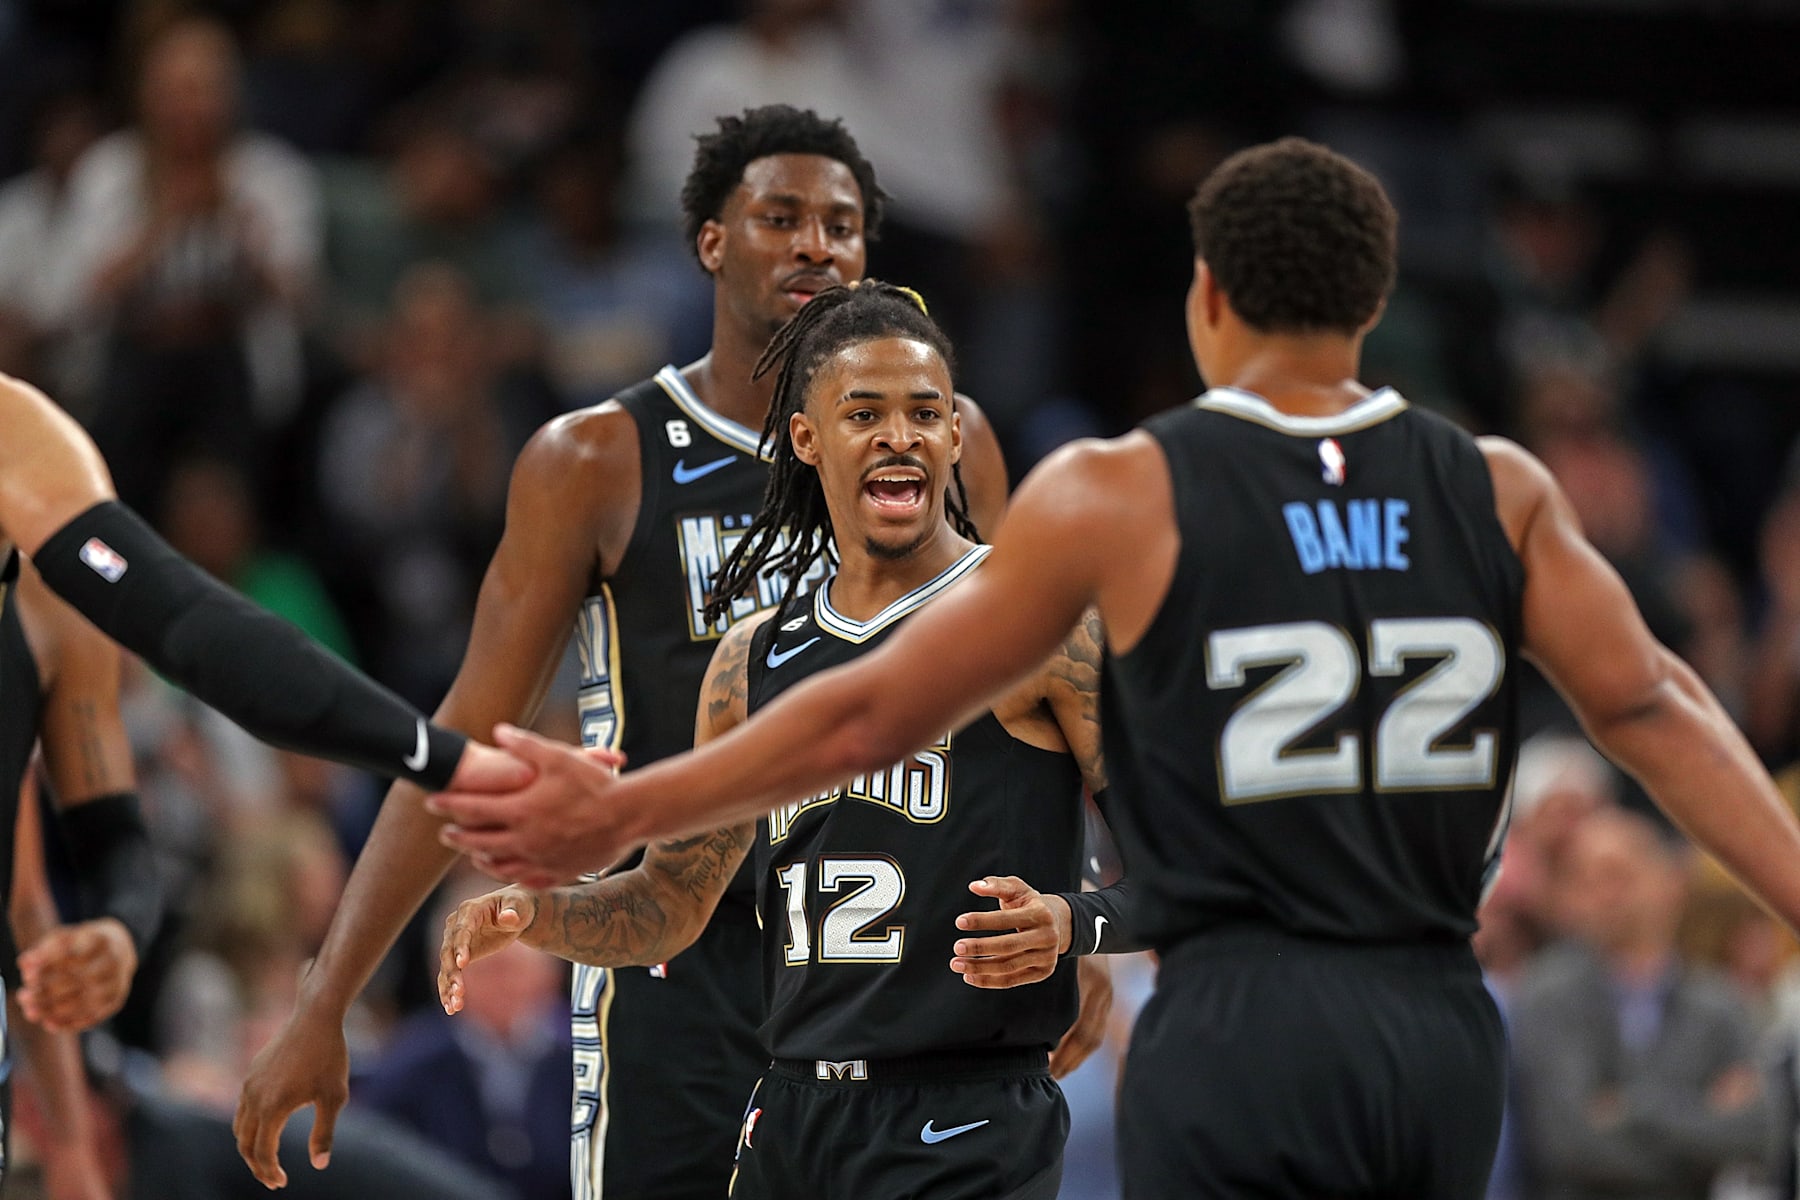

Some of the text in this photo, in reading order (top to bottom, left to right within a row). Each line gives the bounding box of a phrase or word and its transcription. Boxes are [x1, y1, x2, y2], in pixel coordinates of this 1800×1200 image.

[665, 419, 692, 448] 6
[1283, 498, 1411, 575] BANE
[780, 614, 809, 631] 6
[1204, 616, 1507, 806] 22
[776, 852, 906, 967] 12
